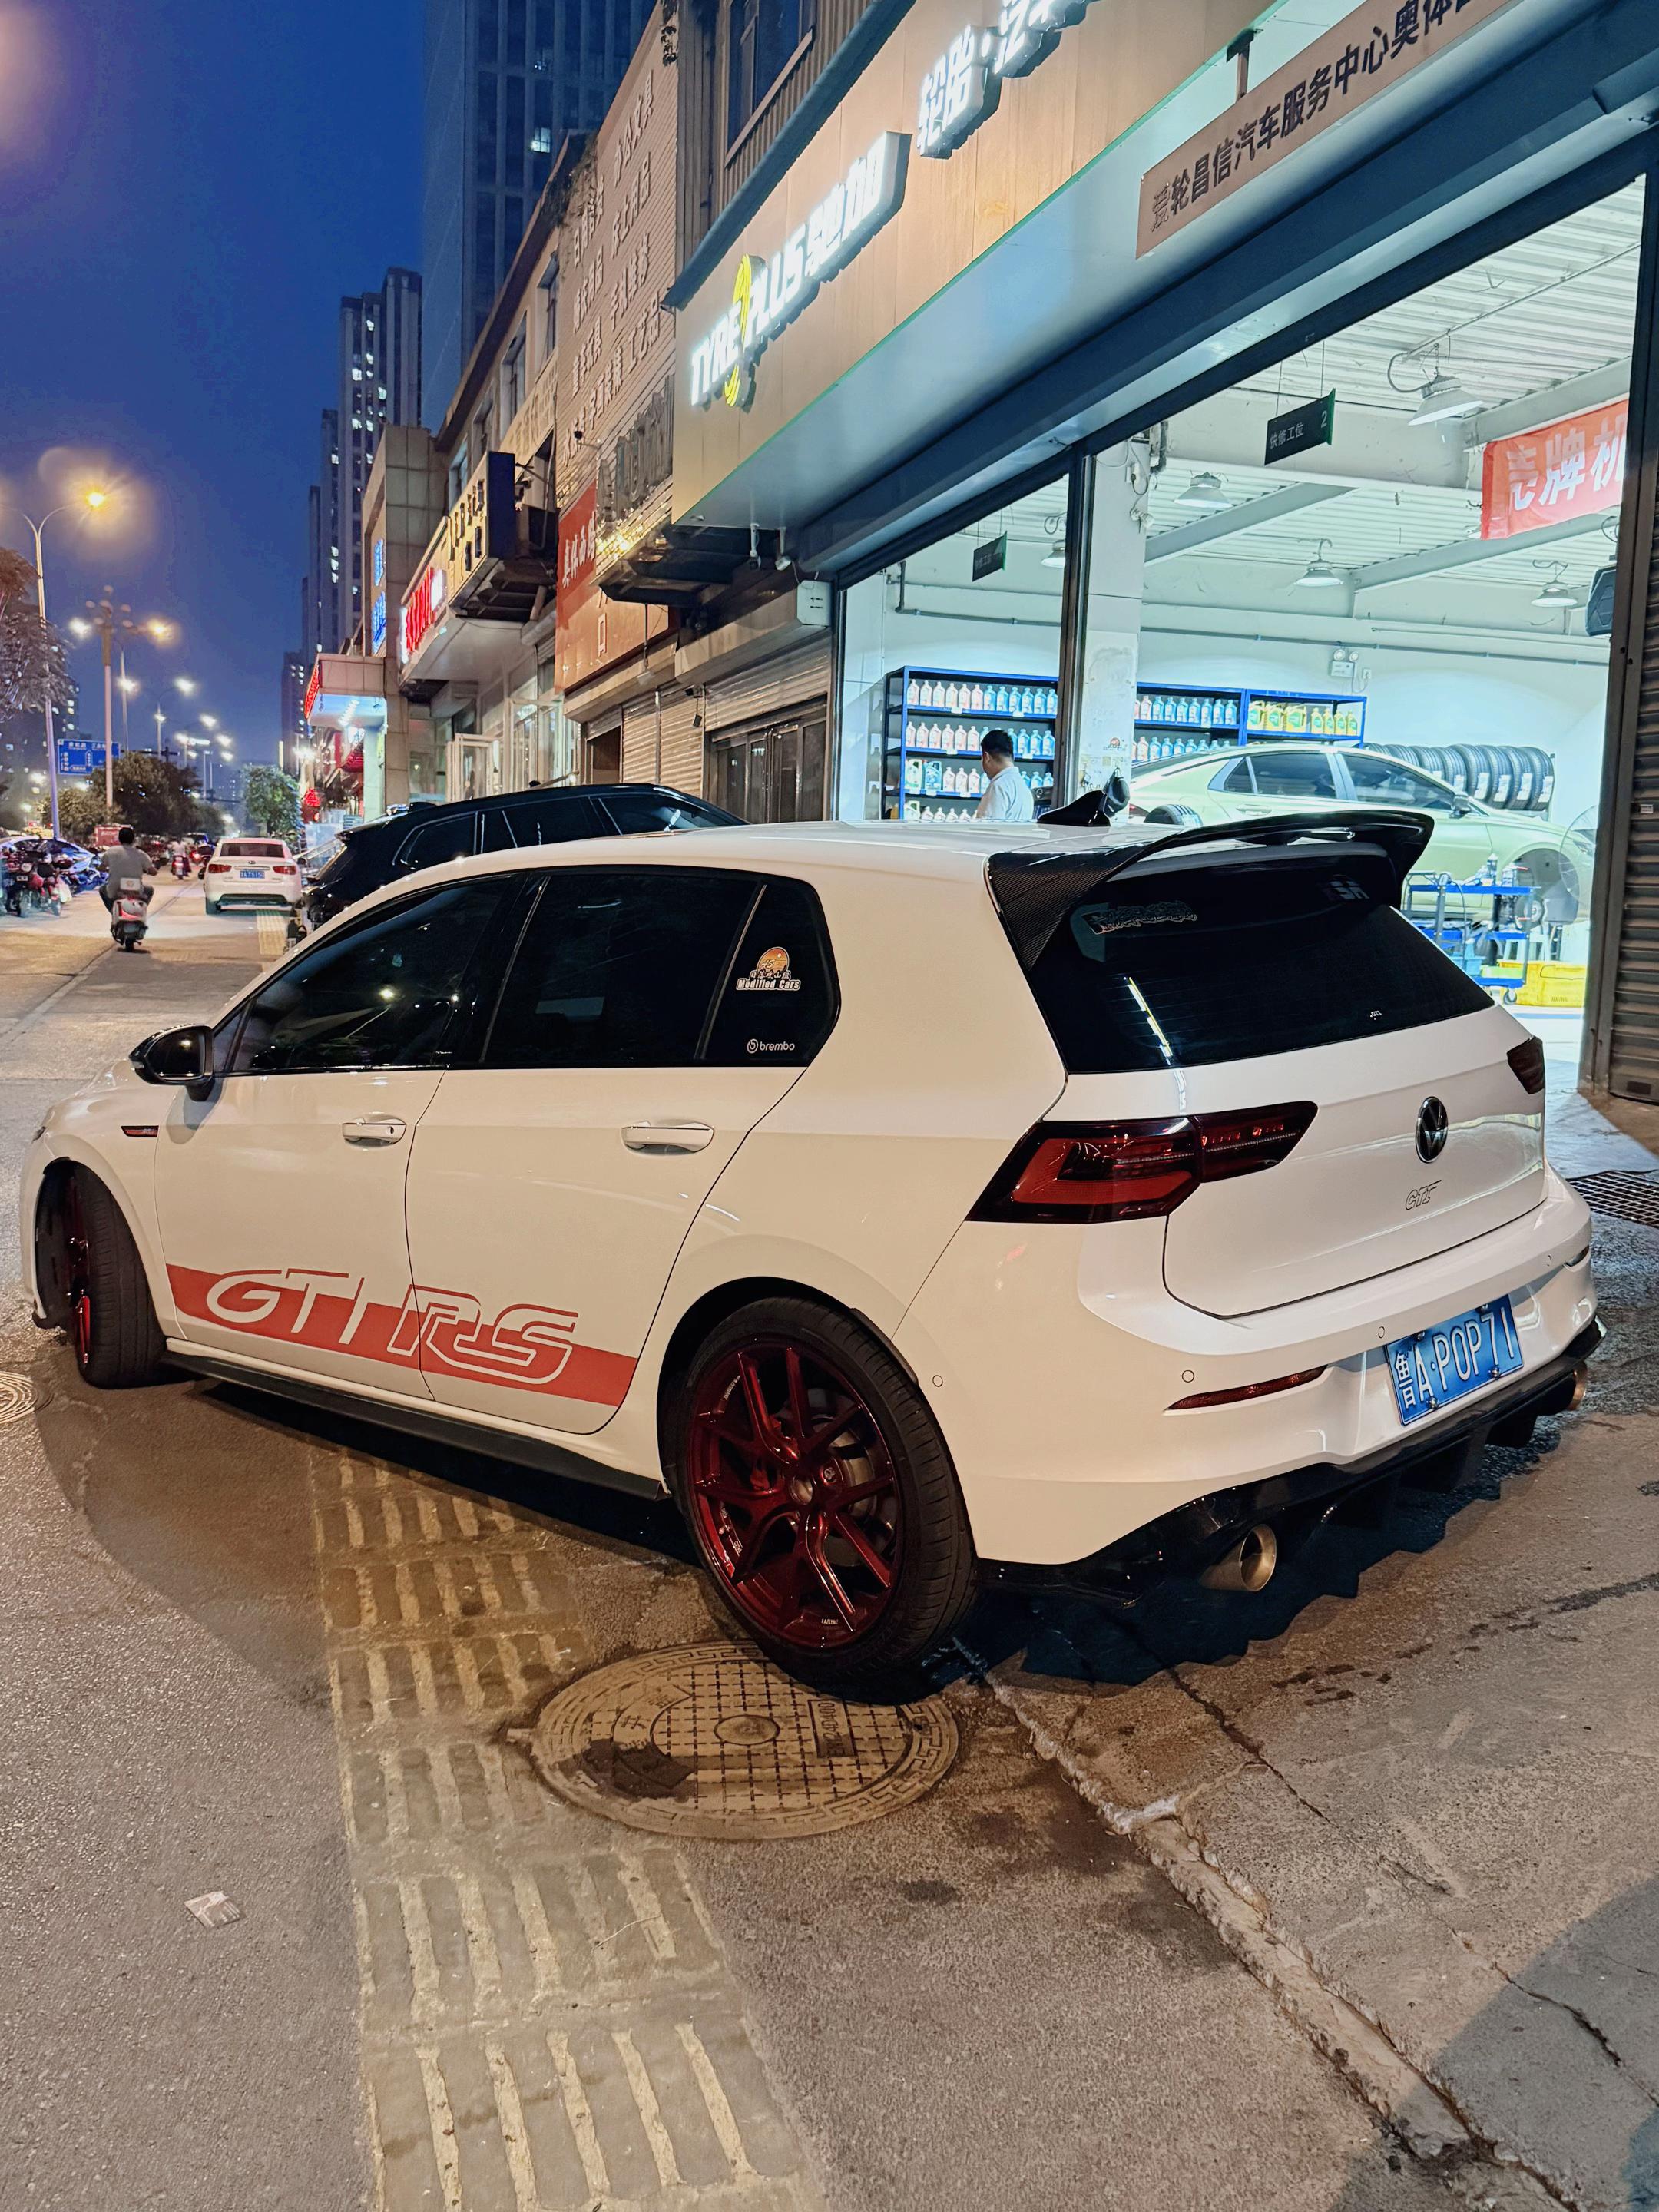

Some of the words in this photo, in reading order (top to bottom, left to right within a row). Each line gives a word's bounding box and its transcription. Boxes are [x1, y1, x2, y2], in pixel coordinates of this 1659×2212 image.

[611, 148, 650, 263] 床上用品
[628, 286, 658, 380] 工艺品
[1320, 410, 1327, 429] 2
[737, 979, 776, 989] Modified
[779, 979, 800, 989] Cars
[760, 1041, 795, 1051] brembo
[206, 1268, 365, 1345] GTI
[386, 1283, 579, 1384] RS
